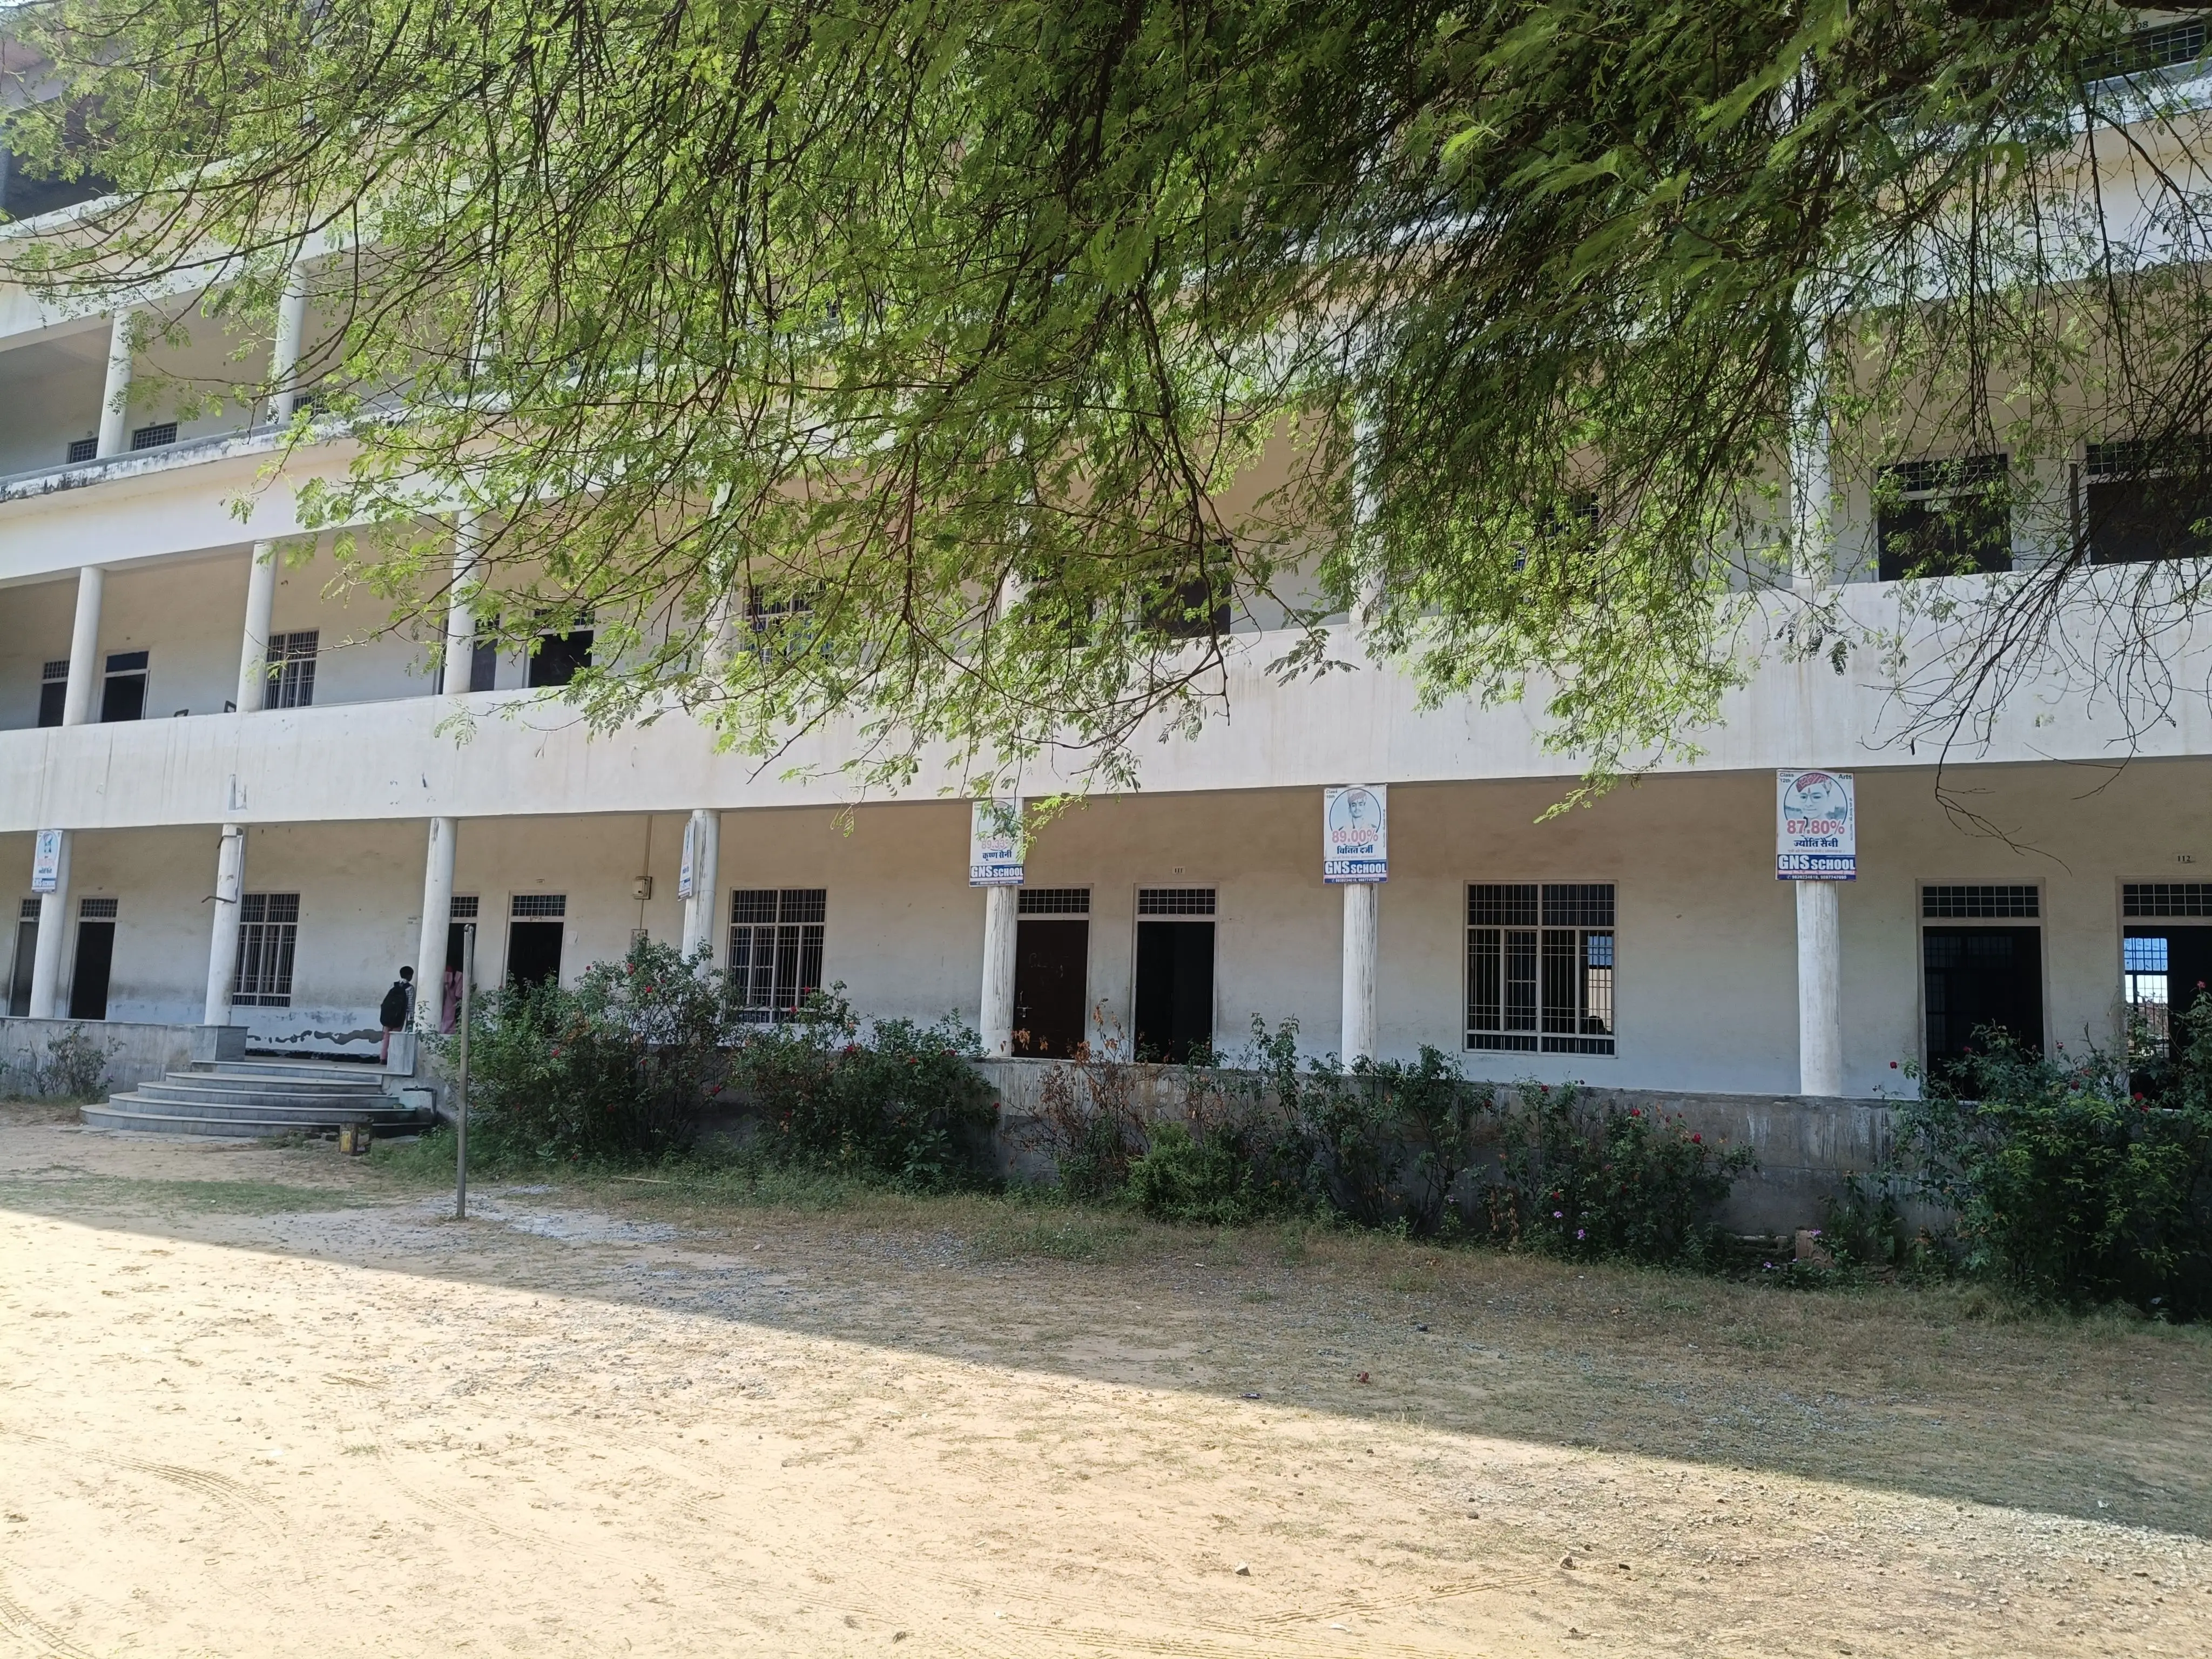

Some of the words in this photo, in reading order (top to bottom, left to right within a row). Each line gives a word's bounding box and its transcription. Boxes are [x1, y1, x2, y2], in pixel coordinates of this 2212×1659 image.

[1787, 820, 1845, 834] 87.80%
[1332, 829, 1379, 844] 89.00%
[1793, 837, 1819, 847] ज्योति
[1820, 837, 1838, 847] सैनी
[1325, 861, 1350, 874] GNS
[1350, 864, 1386, 874] SCHOOL
[1778, 855, 1810, 869] GNS
[1810, 859, 1856, 870] SCHOOL
[970, 866, 993, 878] GNS
[993, 867, 1023, 877] SCHOOL
